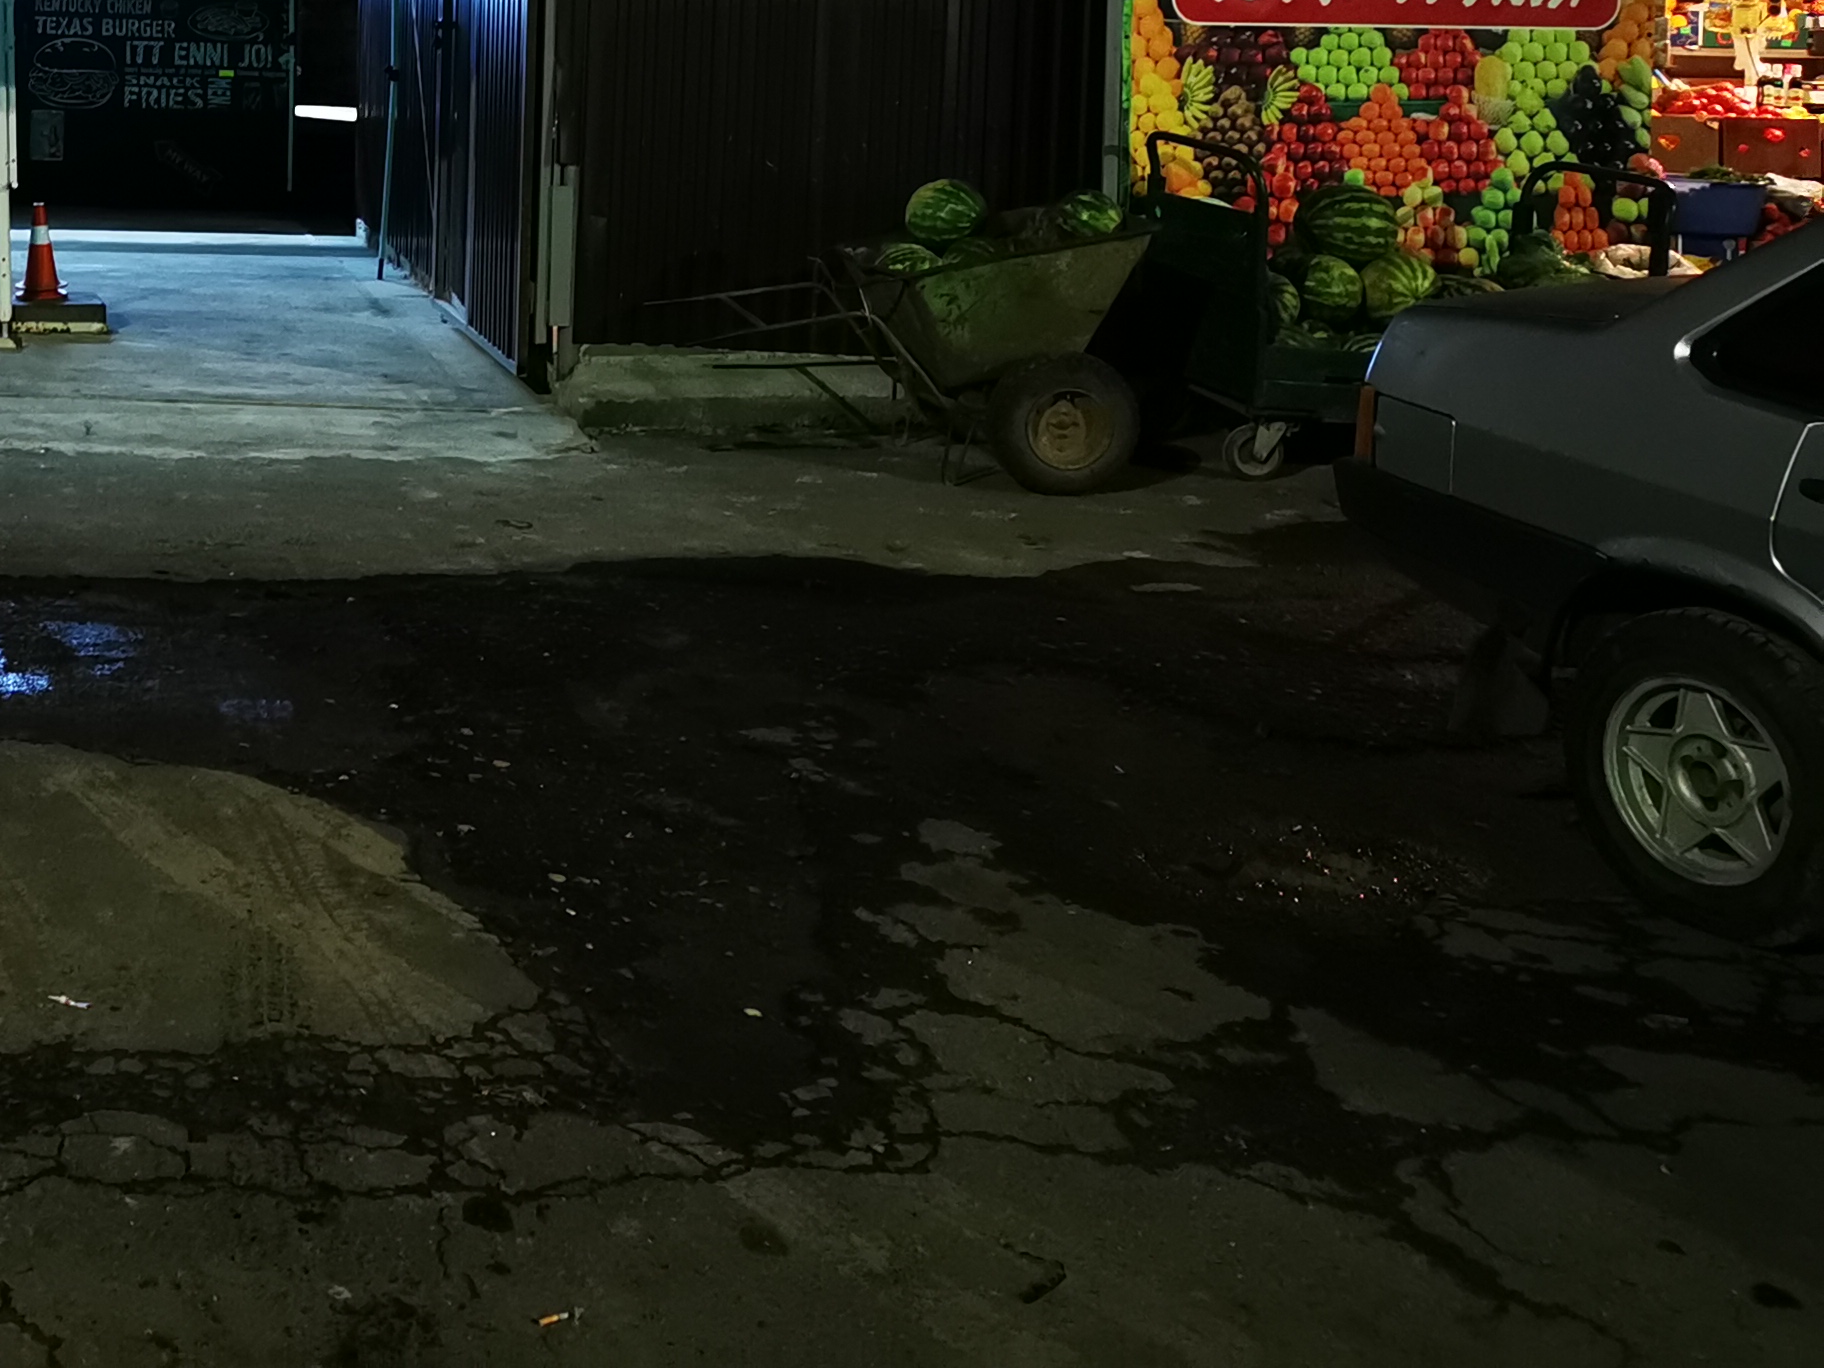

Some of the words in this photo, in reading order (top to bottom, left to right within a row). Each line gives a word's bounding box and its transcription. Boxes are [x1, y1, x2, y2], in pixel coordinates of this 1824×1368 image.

[34, 16, 94, 36] TEXAS
[101, 17, 176, 39] BURGER
[125, 40, 165, 65] ITT
[173, 41, 229, 67] ENNI
[124, 75, 201, 88] SNACK
[123, 86, 204, 110] FRIES
